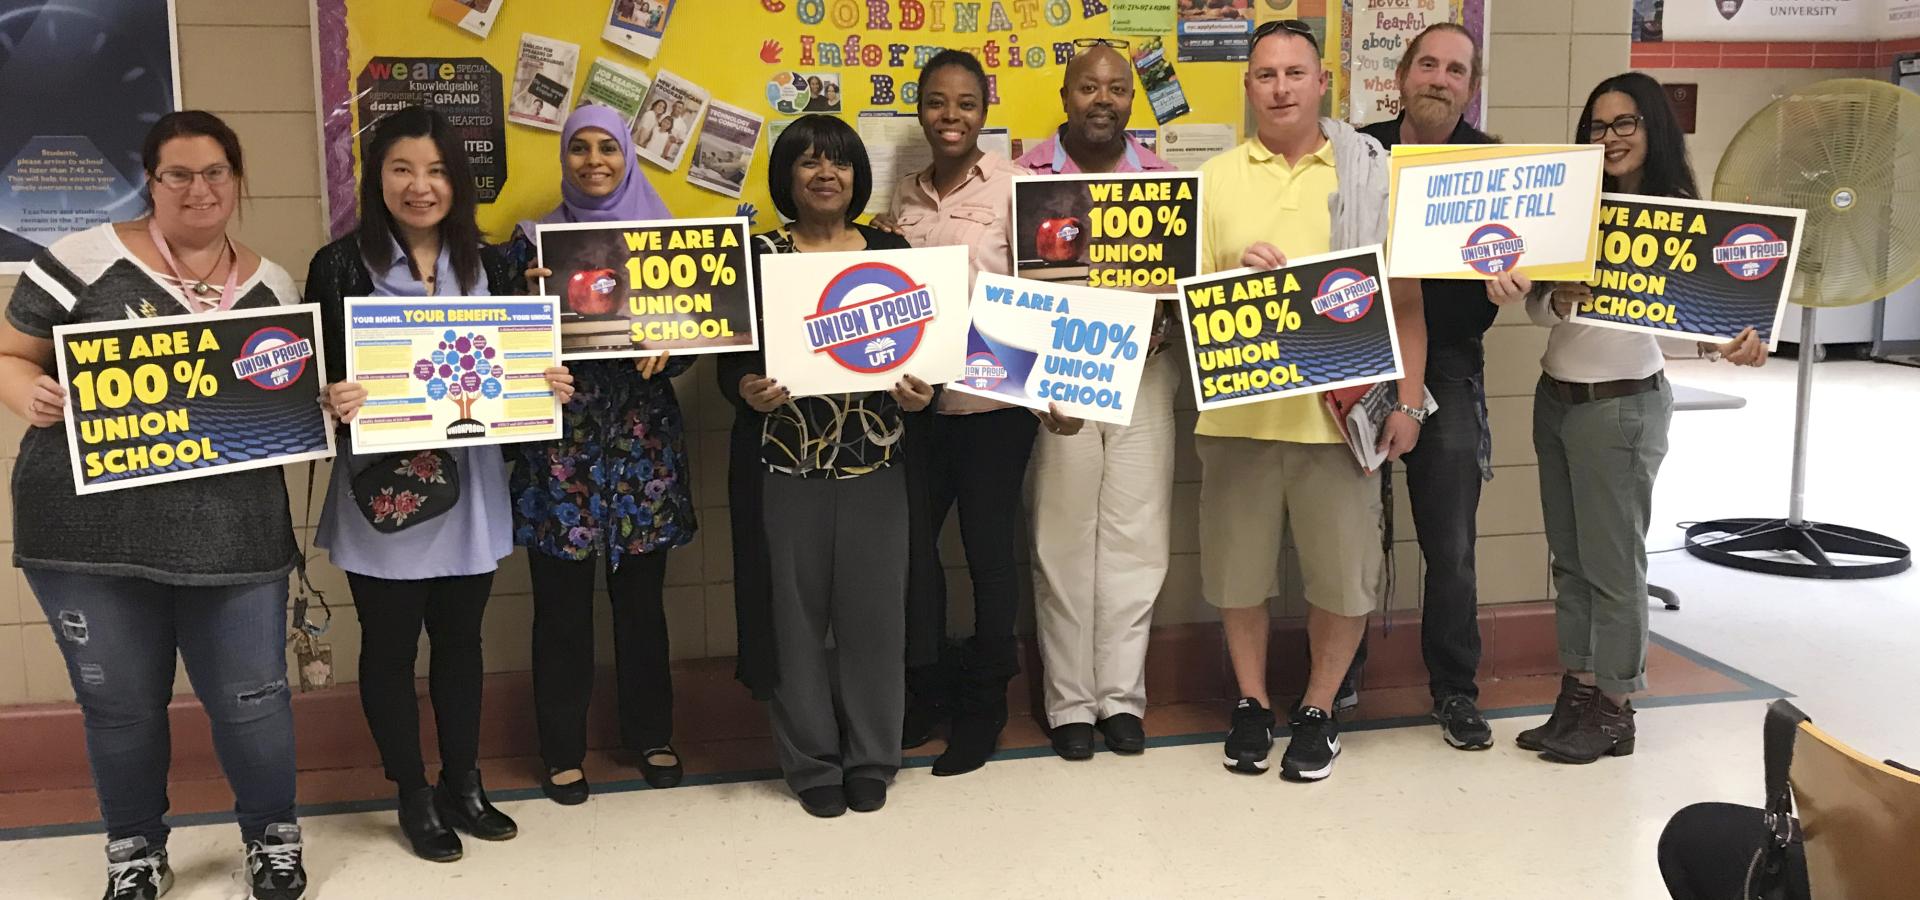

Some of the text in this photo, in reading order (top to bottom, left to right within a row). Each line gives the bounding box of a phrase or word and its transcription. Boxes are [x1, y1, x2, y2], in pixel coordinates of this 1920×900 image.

[1376, 12, 1427, 31] fearful
[1770, 6, 1838, 16] UNIVERSITY
[1362, 32, 1402, 50] about
[368, 63, 456, 80] we are
[457, 64, 491, 73] SPECIAL
[1383, 57, 1399, 70] ar
[409, 80, 479, 92] knowledgeable
[434, 93, 480, 105] GRAND
[1376, 94, 1402, 115] rig
[1088, 182, 1192, 202] WE ARE A
[1426, 163, 1566, 199] UNITED WE STAND
[1425, 193, 1556, 227] DIVIDED WE FALL
[1634, 209, 1684, 232] ARE
[1688, 214, 1707, 235] A
[624, 228, 739, 251] WE ARE A
[1461, 238, 1524, 262] UNION PROUD
[1089, 243, 1163, 263] UNION
[1716, 242, 1785, 262] UNION PROUD
[1088, 267, 1177, 288] SCHOOL
[1743, 269, 1758, 277] UFT
[985, 285, 1070, 314] WE ARE A
[1187, 273, 1301, 308] WE ARE A
[1315, 278, 1376, 313] UNION PROUD
[353, 316, 374, 324] YOUR
[375, 315, 403, 323] RIGHTS.
[403, 309, 445, 323] YOUR
[447, 308, 512, 322] BENEFITS.
[629, 293, 712, 316] UNION
[630, 318, 734, 342] SCHOOL
[806, 288, 934, 349] UNION PROUD
[68, 328, 220, 365] WE ARE A
[1050, 315, 1139, 361] 100%
[235, 342, 312, 377] UNION PROUD
[869, 350, 896, 367] UFT
[1198, 340, 1280, 371] UNION
[981, 366, 1005, 377] PROUD
[1044, 355, 1115, 382] UNION
[1203, 363, 1304, 397] SCHOOL
[273, 375, 290, 386] UFT
[1037, 378, 1122, 410] SCHOOL
[80, 408, 191, 444] UNION
[84, 437, 220, 477] SCHOOL
